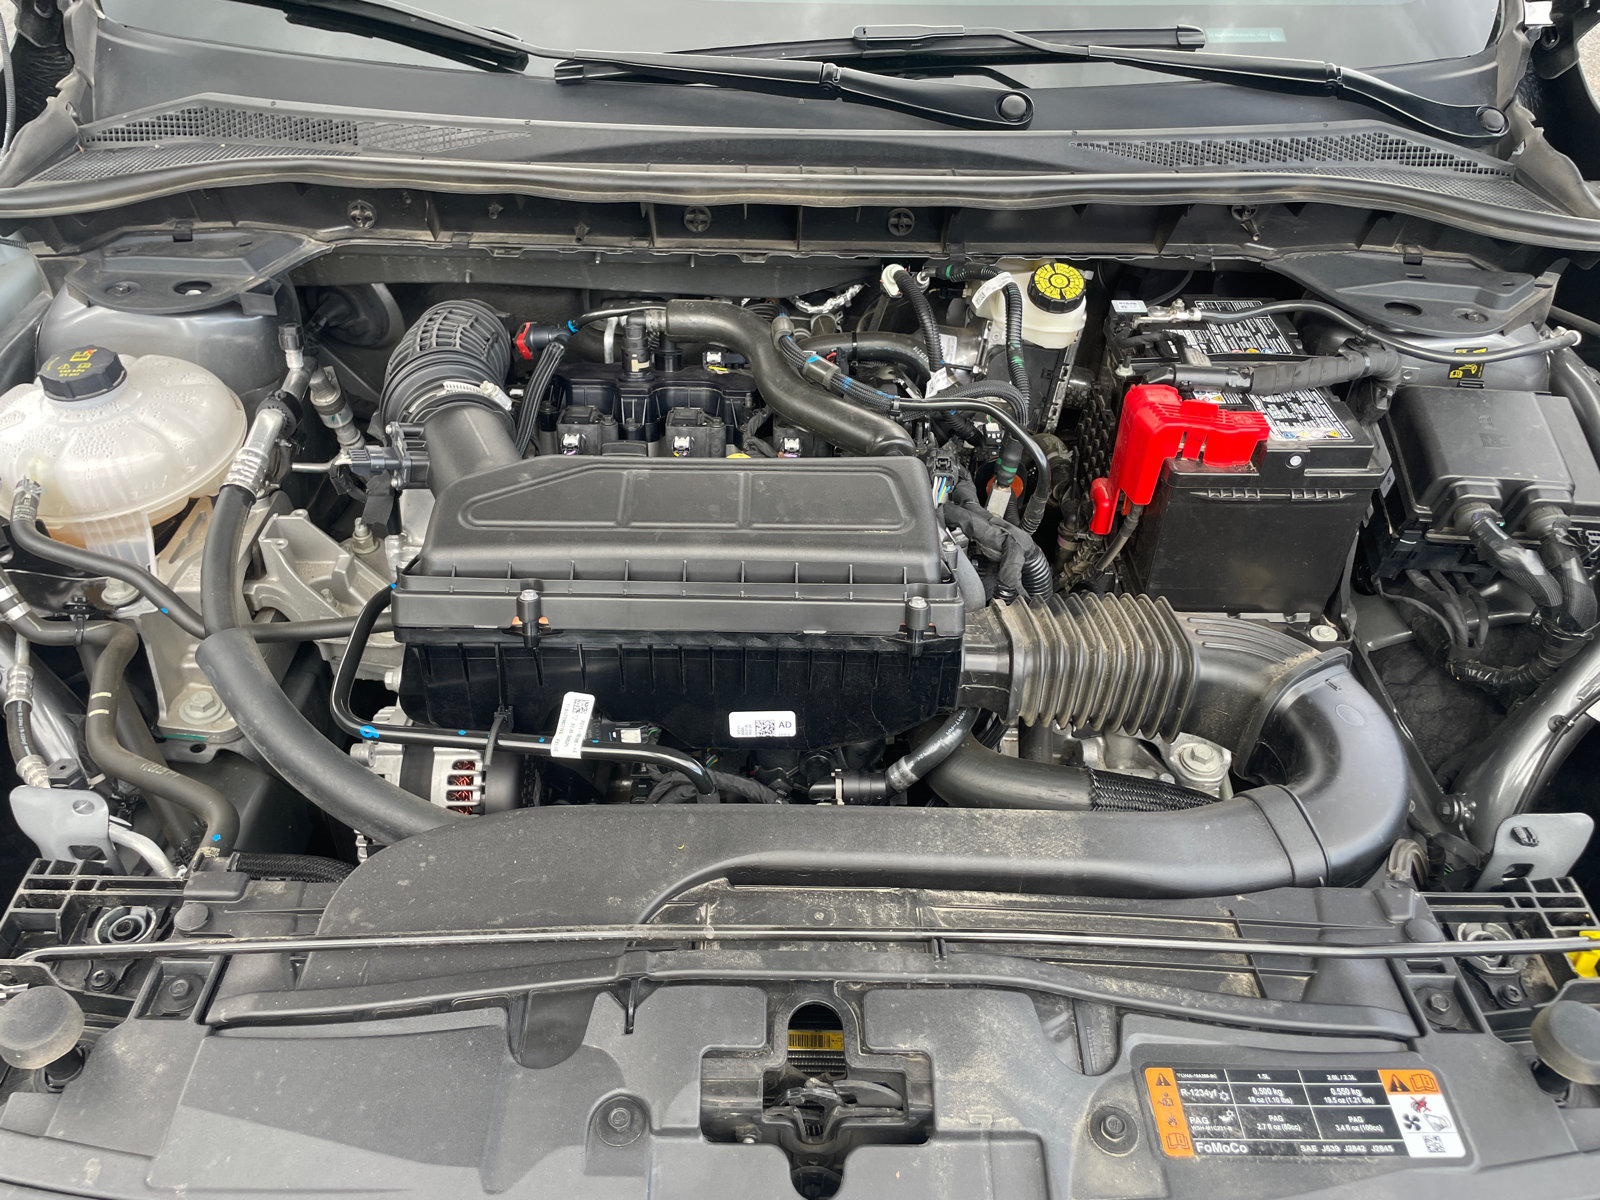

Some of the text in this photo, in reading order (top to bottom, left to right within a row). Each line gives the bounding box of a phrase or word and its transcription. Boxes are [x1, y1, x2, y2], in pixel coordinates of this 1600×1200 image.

[779, 721, 792, 729] AD
[1180, 1088, 1218, 1099] R-1234yf
[1252, 1088, 1284, 1097] 0.500 kg
[1330, 1088, 1363, 1097] 0.550 kg
[1265, 1096, 1280, 1104] (1.10
[1281, 1096, 1293, 1104] lbs)
[1346, 1097, 1361, 1105] (1.21
[1362, 1097, 1375, 1105] lbs)
[1189, 1116, 1209, 1125] PAG
[1360, 1124, 1384, 1133] (100cc)
[1195, 1142, 1249, 1153] FoMoCo
